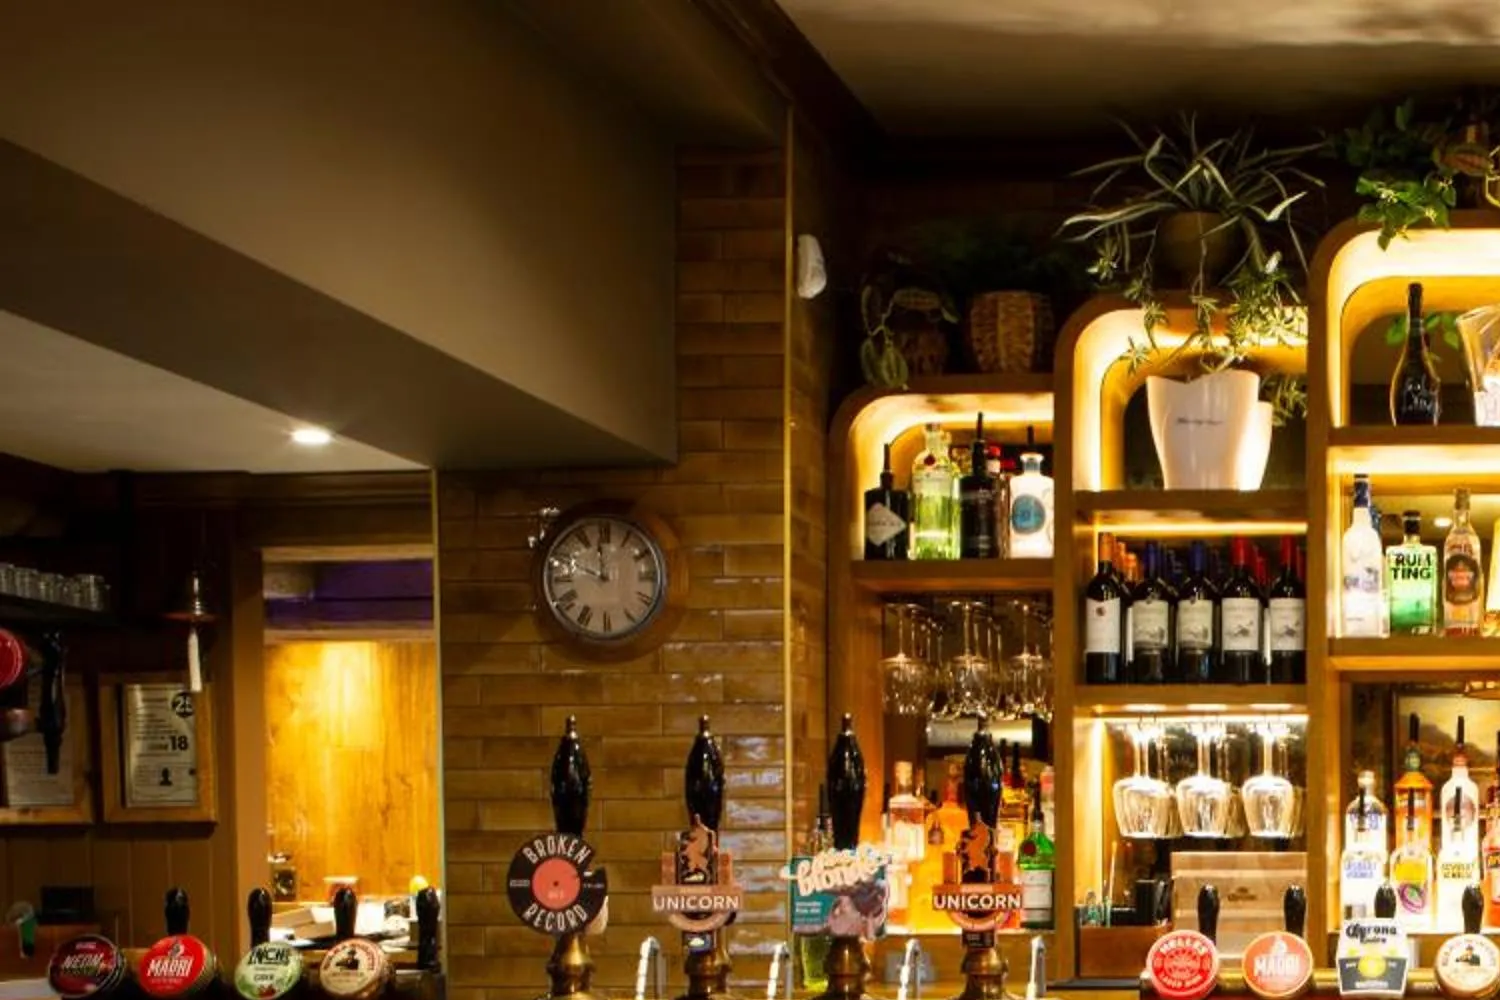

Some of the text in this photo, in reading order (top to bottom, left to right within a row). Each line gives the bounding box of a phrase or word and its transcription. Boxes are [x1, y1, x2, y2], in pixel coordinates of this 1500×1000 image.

[1391, 567, 1432, 580] TING
[169, 735, 188, 751] 18
[522, 835, 592, 864] BROKEN
[653, 895, 740, 912] UNICORN
[933, 893, 1021, 910] UNICORN
[523, 902, 588, 932] RECORD
[1346, 923, 1397, 939] Corona
